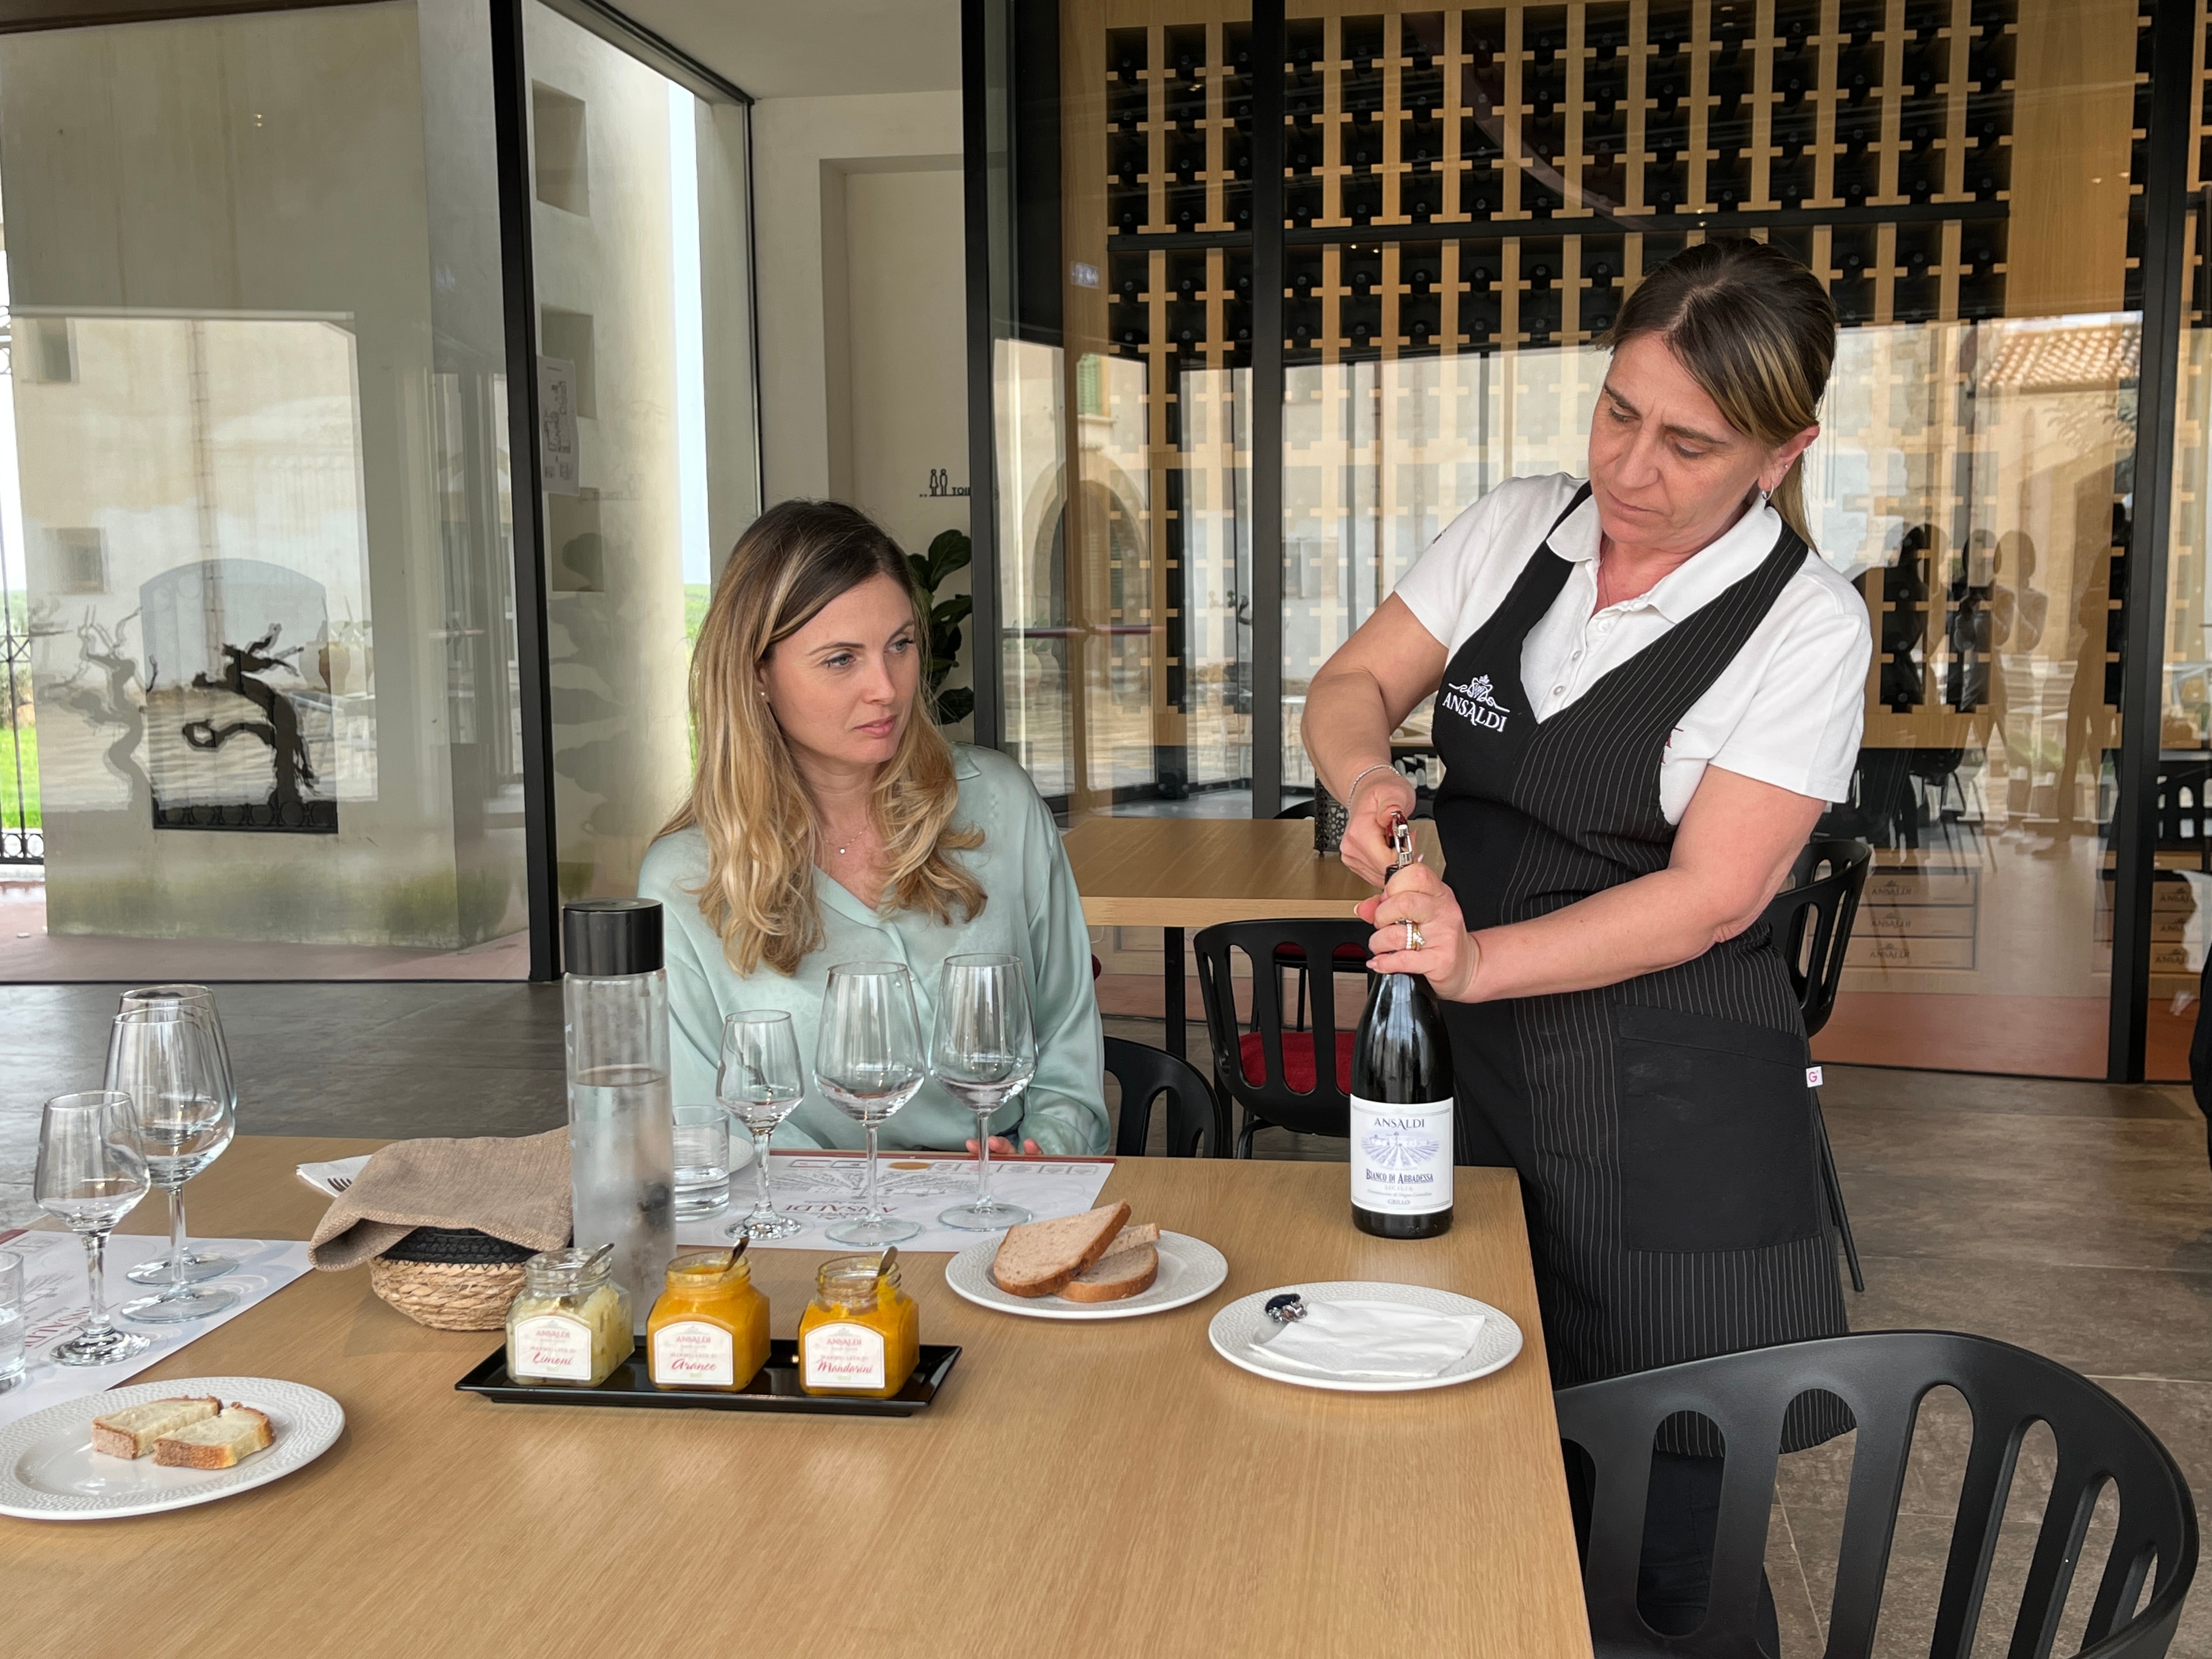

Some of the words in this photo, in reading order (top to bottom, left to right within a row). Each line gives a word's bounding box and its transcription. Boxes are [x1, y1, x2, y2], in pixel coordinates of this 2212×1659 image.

[1442, 692, 1508, 732] ANSALDI
[1374, 1118, 1424, 1130] ANSALDI
[1366, 1169, 1387, 1181] BIANCO
[1398, 1173, 1433, 1184] ABBADESSA
[827, 1338, 861, 1346] ANSALDI
[533, 1351, 573, 1365] Limoni
[671, 1358, 717, 1370] Arance
[816, 1359, 873, 1373] Mandarini
